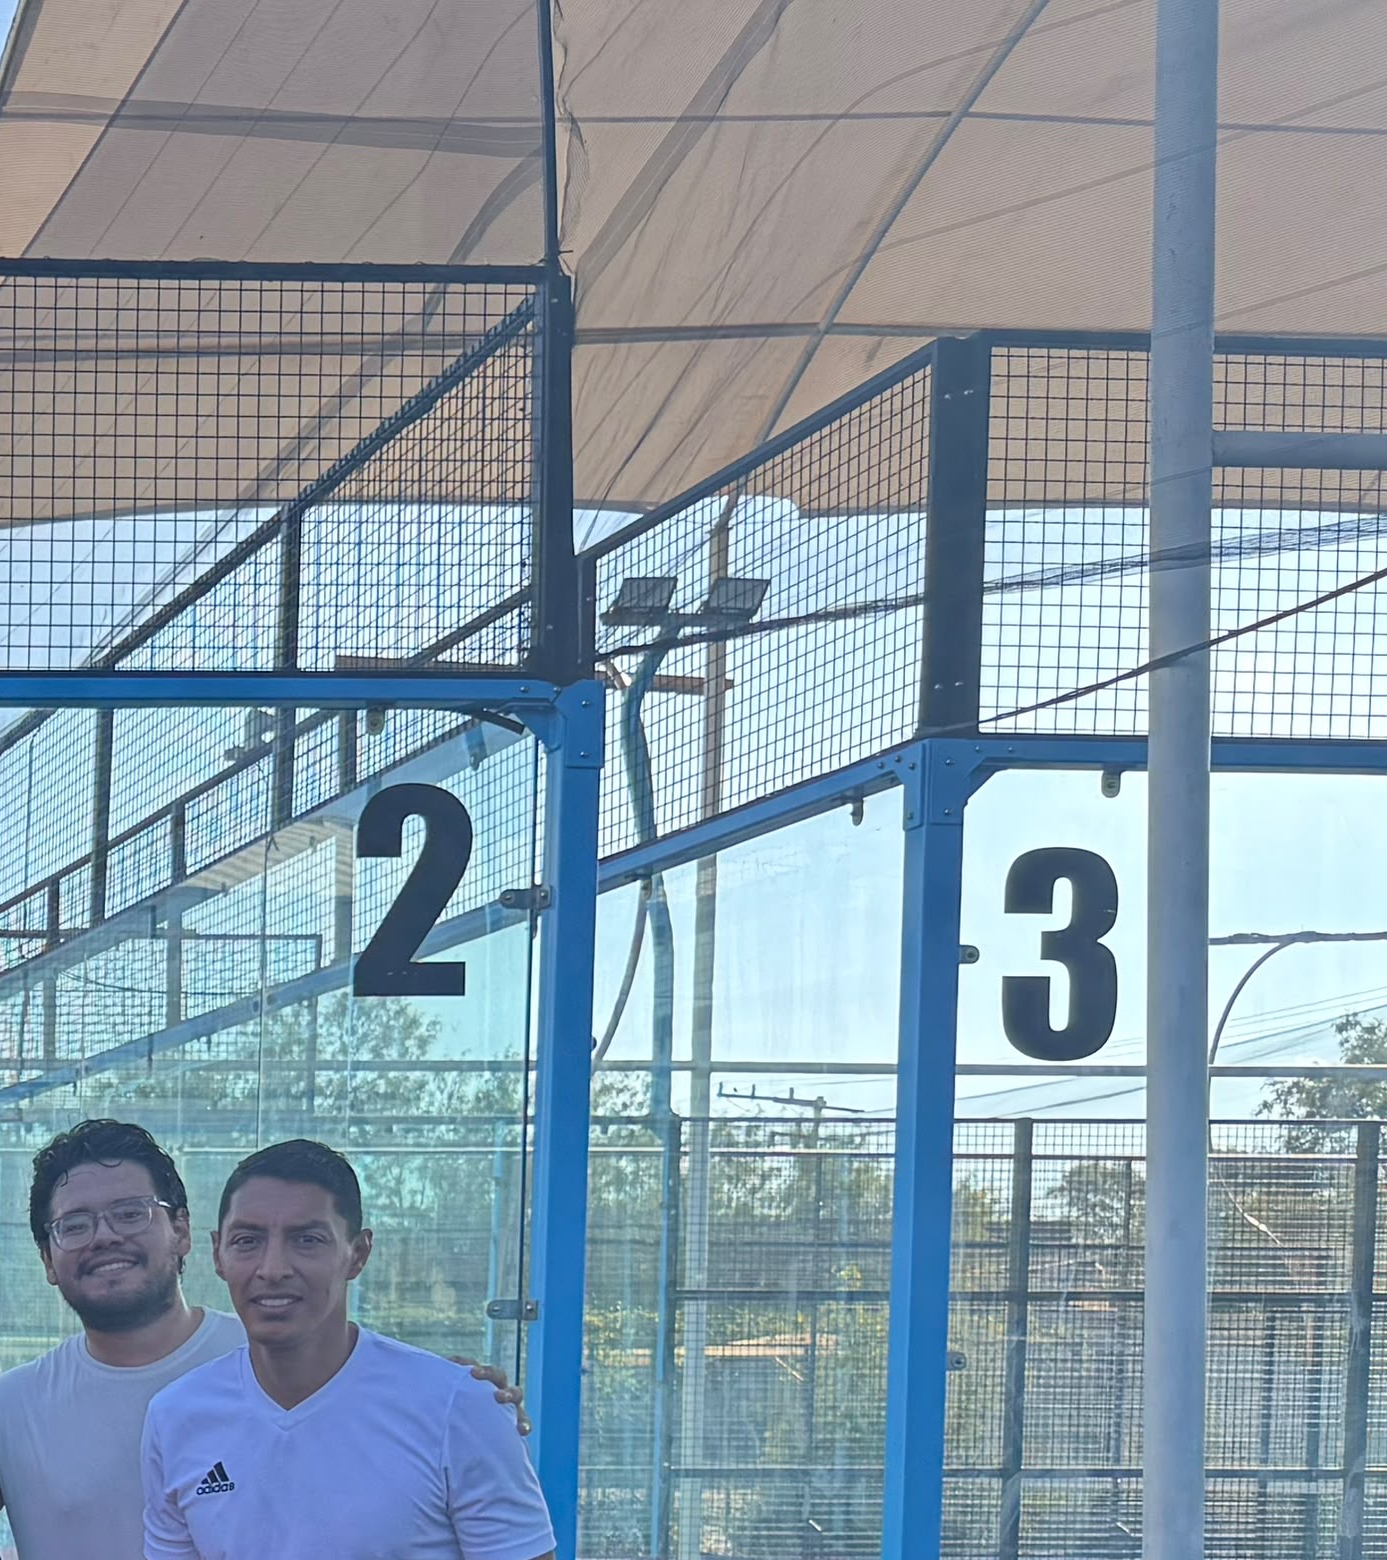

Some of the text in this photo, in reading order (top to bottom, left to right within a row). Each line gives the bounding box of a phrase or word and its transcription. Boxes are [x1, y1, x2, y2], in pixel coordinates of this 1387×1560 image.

[352, 783, 473, 998] 2
[1002, 846, 1119, 1062] 3
[195, 1481, 235, 1496] adidas
